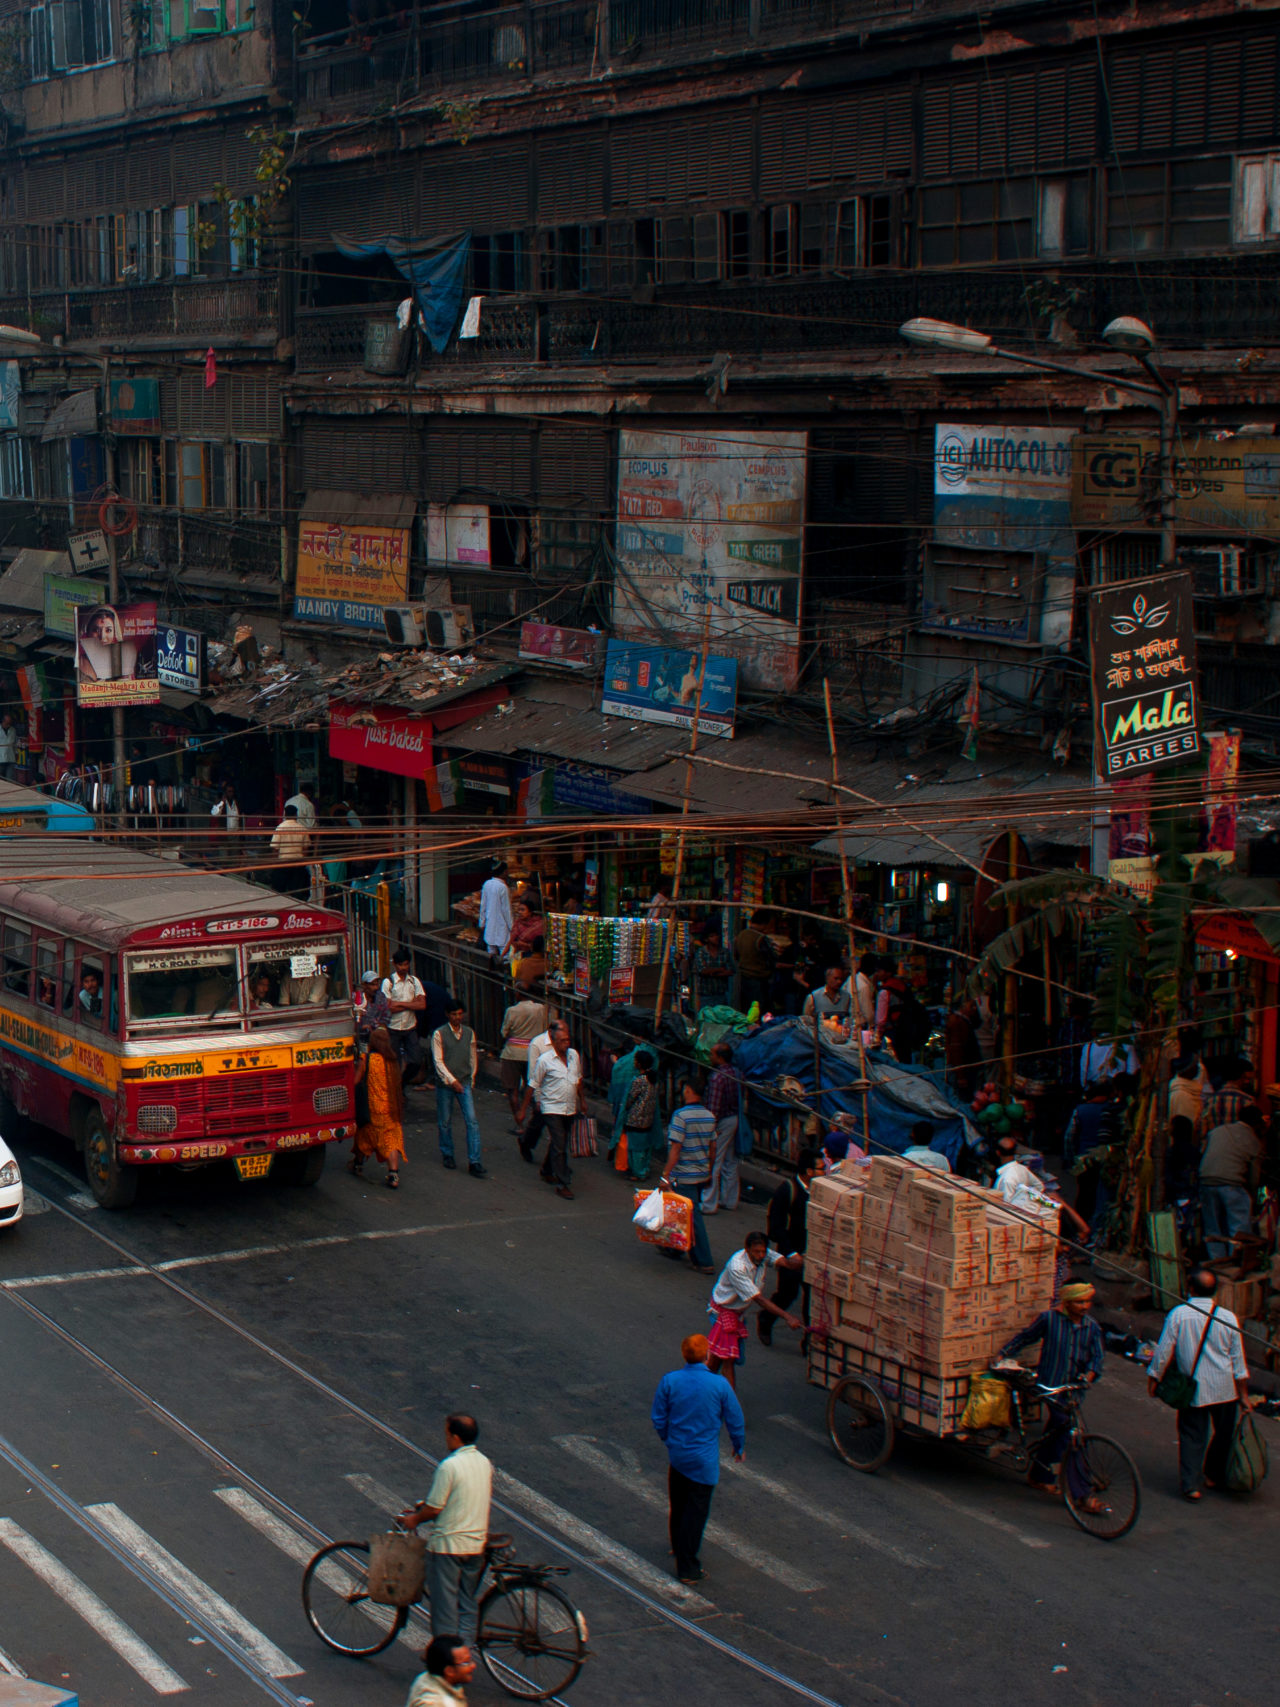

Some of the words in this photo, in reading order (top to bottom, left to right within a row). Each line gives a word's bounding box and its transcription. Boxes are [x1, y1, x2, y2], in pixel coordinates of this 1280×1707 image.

[628, 460, 668, 475] ECOPLUS
[622, 496, 642, 516] TATA
[645, 500, 663, 515] RED
[297, 598, 339, 617] NANDY
[751, 584, 783, 613] BLACK
[164, 674, 195, 688] STORES
[1110, 690, 1192, 744] Mala
[389, 726, 424, 753] baked
[1111, 736, 1193, 769] SAREES
[283, 914, 317, 930] Bus
[170, 957, 201, 967] ROAD.
[181, 1144, 227, 1159] SPEED
